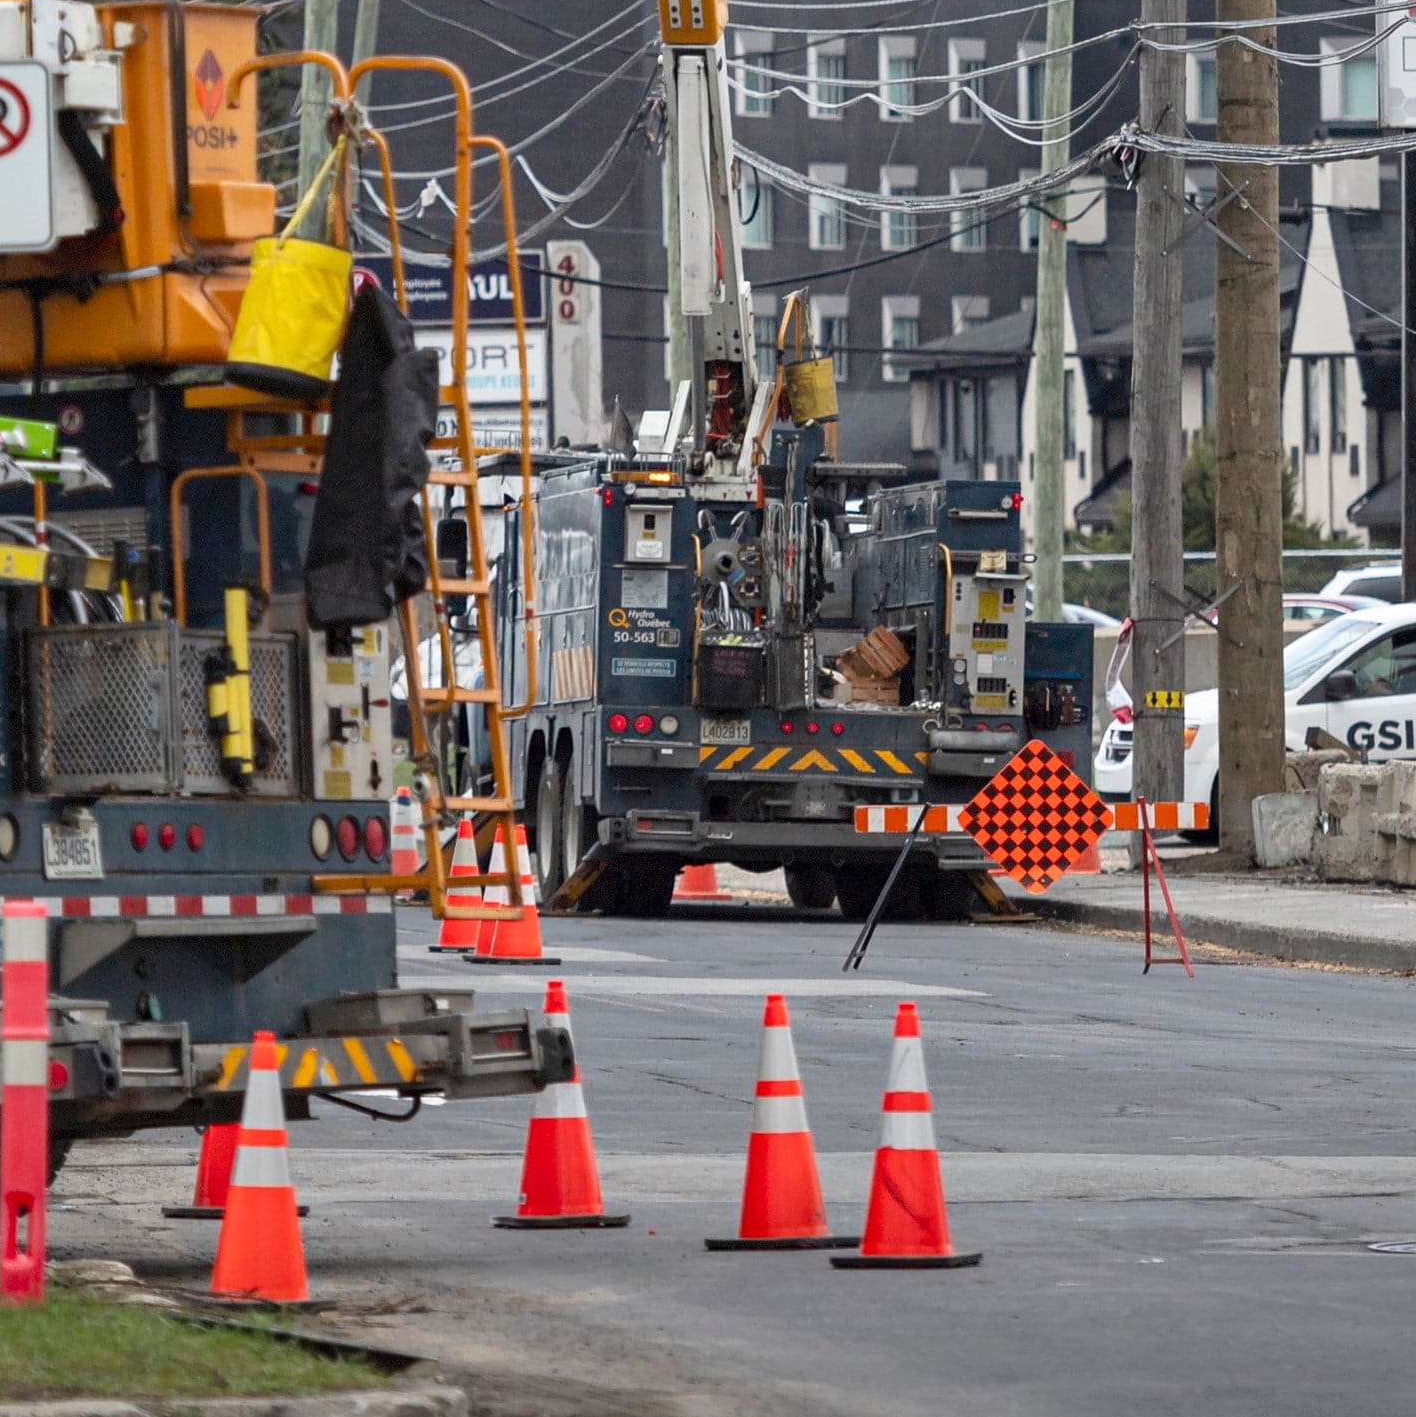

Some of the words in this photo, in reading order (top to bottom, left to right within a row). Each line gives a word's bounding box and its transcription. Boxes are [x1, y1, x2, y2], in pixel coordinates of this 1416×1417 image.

[627, 610, 655, 621] Hydro
[637, 618, 671, 628] Québec
[614, 631, 655, 643] 50-563
[1346, 720, 1415, 752] GSI
